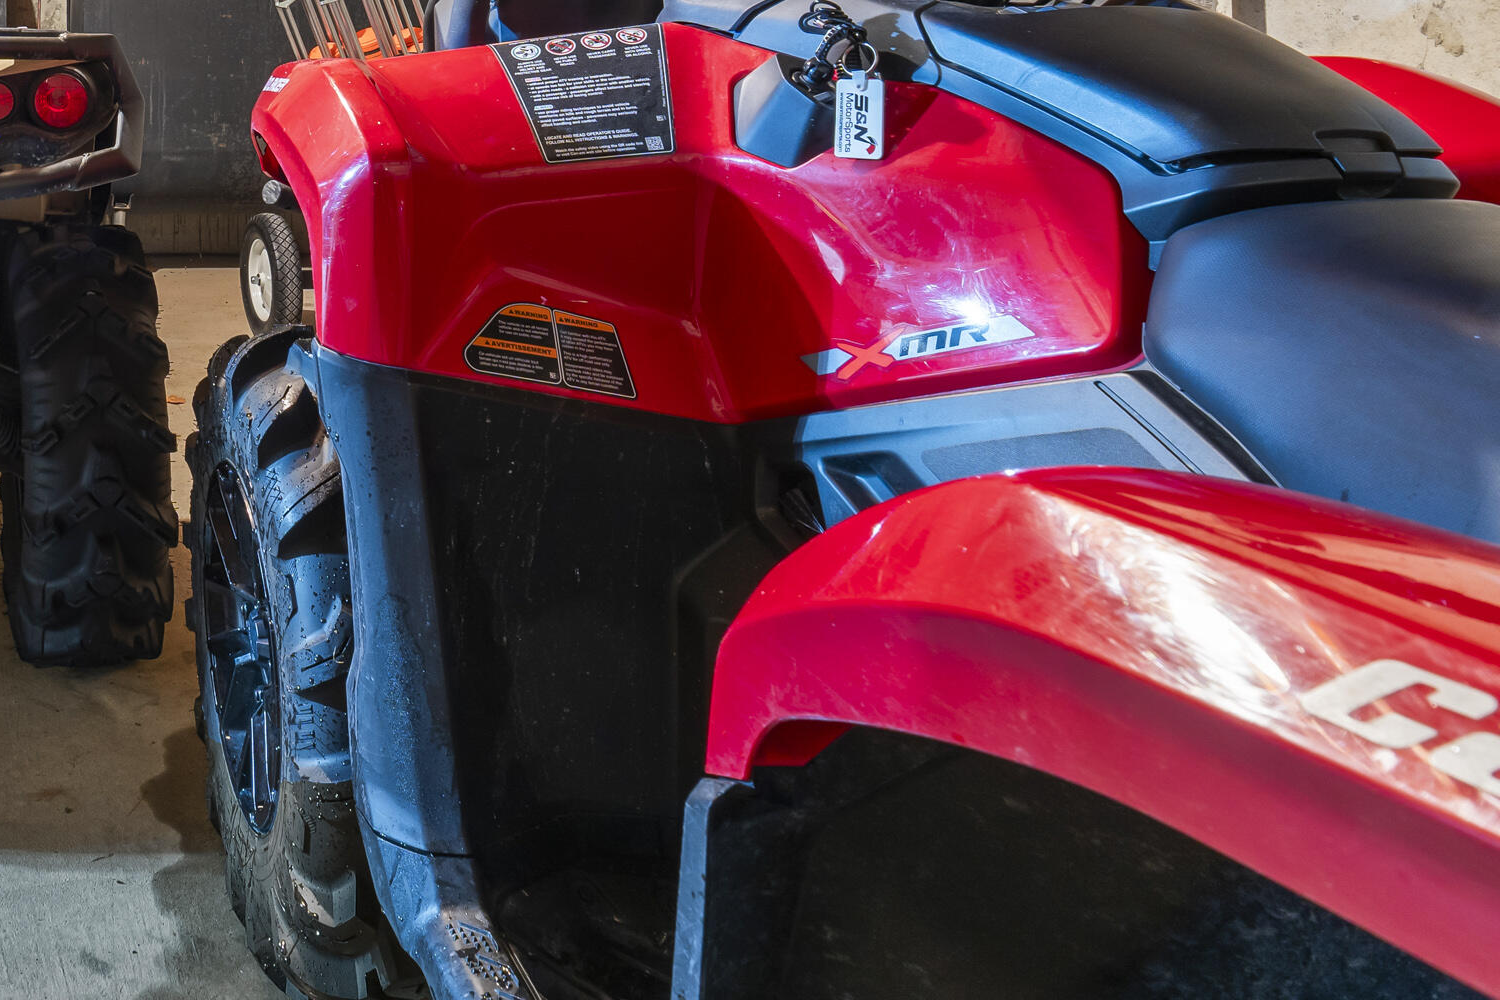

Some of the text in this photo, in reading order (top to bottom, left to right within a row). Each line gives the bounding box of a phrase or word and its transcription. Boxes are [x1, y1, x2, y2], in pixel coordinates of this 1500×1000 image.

[844, 92, 854, 153] MotorSports
[854, 93, 878, 146] S&N
[514, 309, 549, 320] WARNING
[563, 317, 598, 328] WARNING
[491, 341, 552, 356] AVERTISSEMENT
